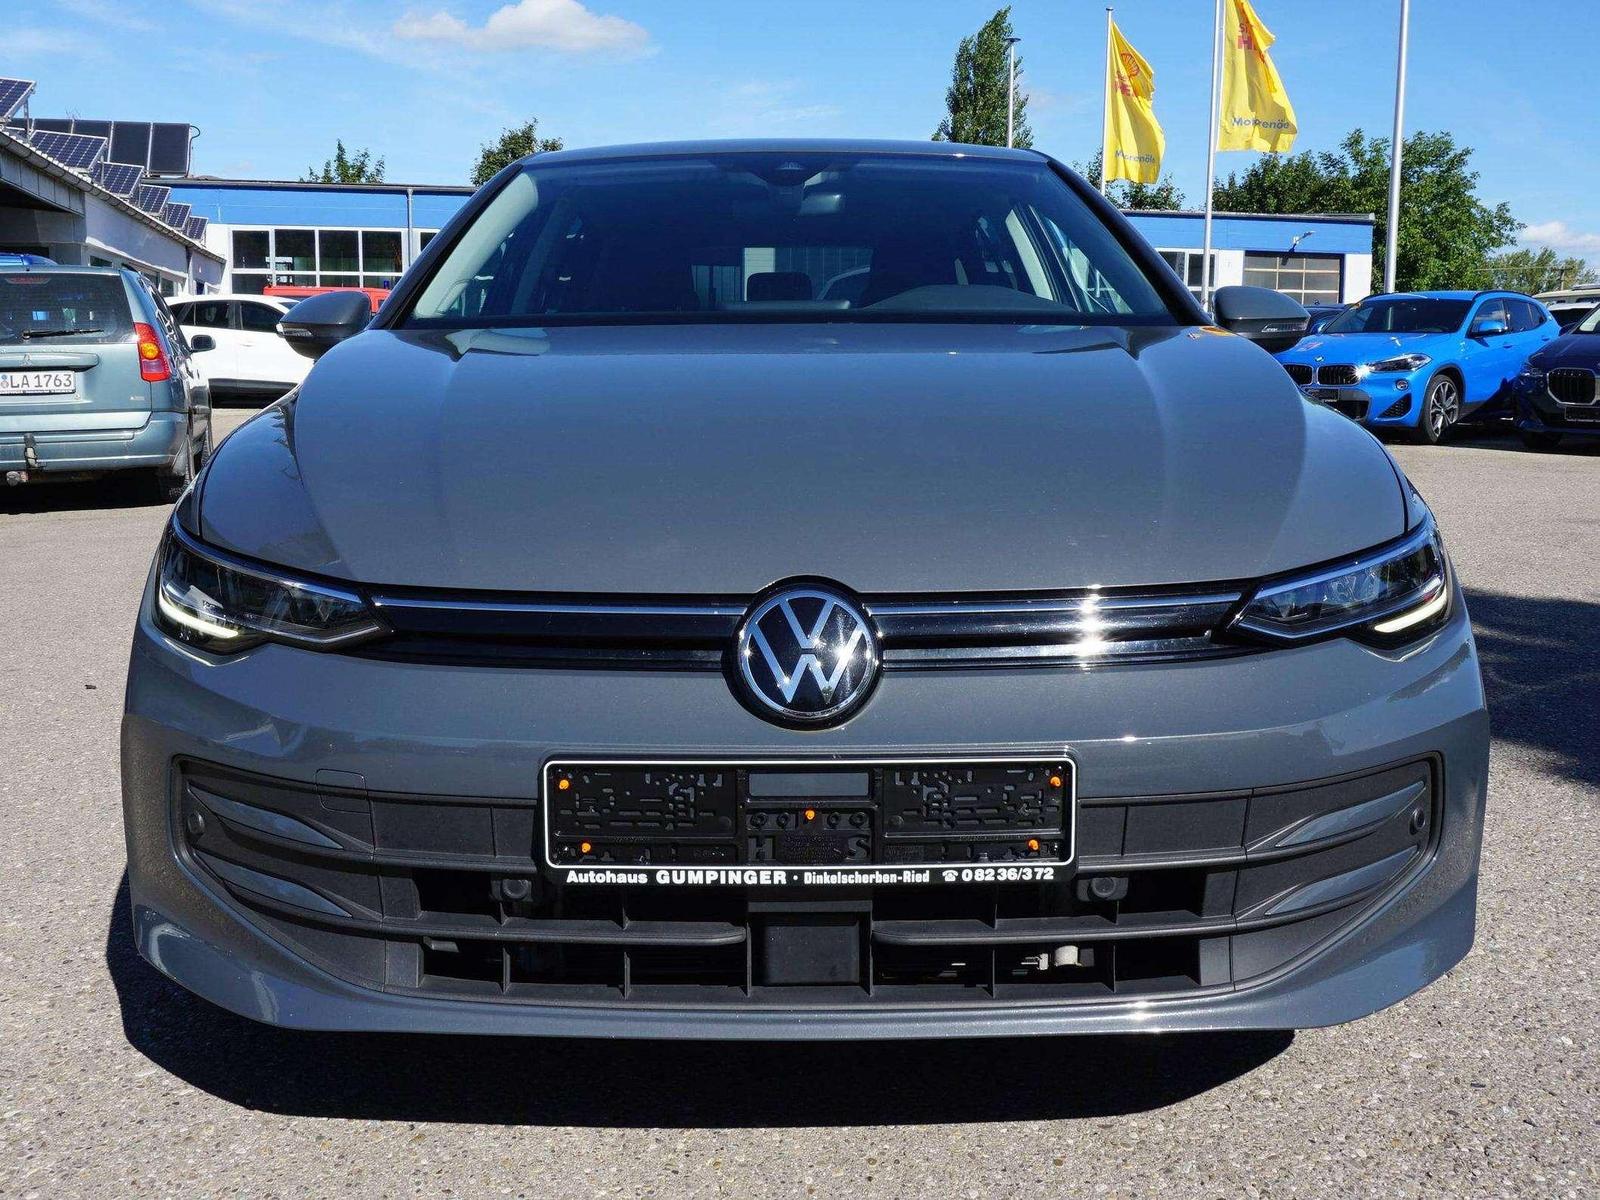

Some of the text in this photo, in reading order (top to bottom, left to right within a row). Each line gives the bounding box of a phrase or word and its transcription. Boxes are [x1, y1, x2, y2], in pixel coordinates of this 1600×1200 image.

[10, 374, 72, 388] LA 1763
[747, 595, 867, 707] VW
[566, 869, 648, 884] Autohaus
[656, 870, 788, 885] GUMPINGER
[803, 870, 930, 885] Dinkelscherben-Ried
